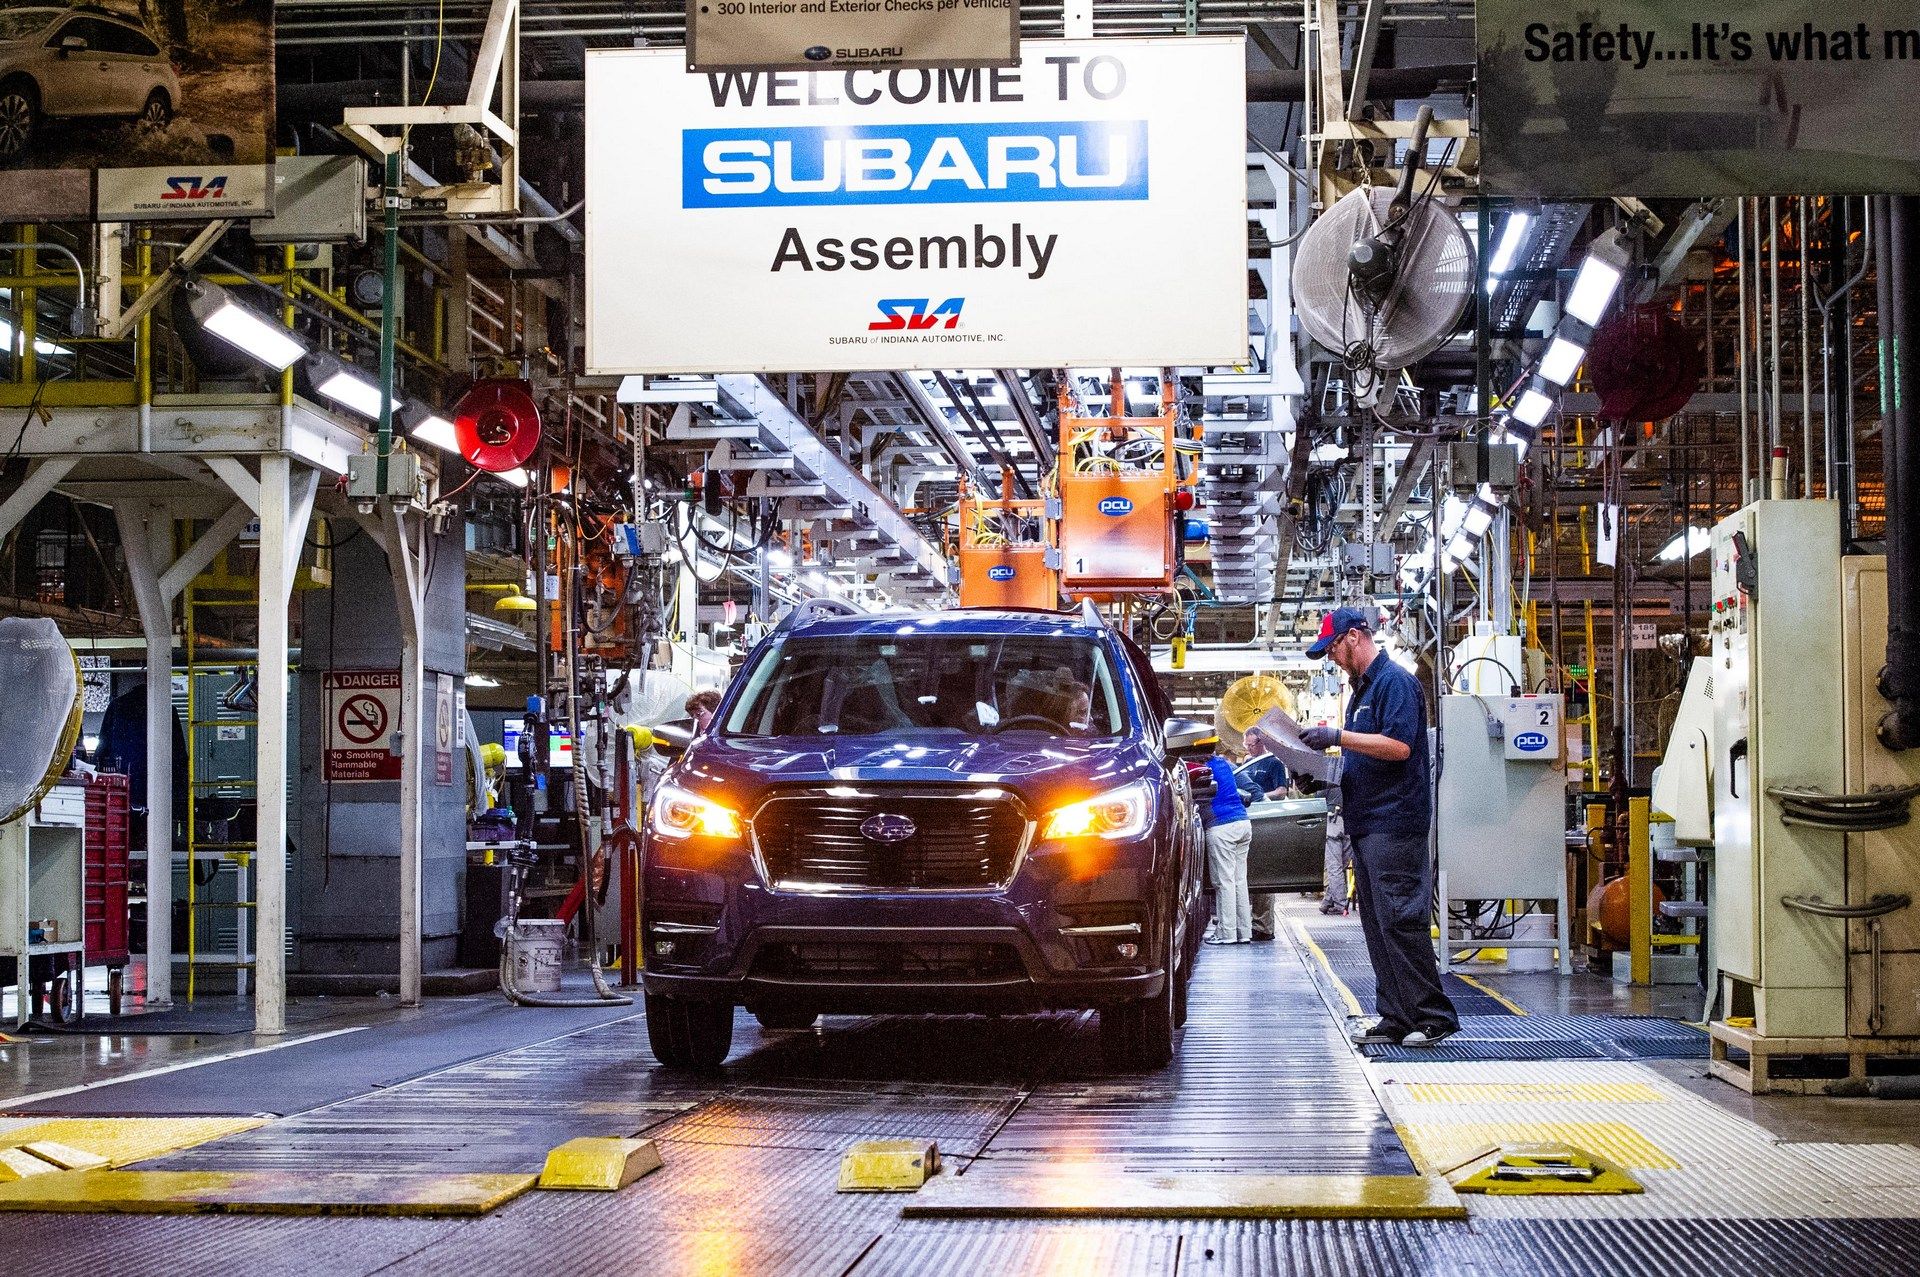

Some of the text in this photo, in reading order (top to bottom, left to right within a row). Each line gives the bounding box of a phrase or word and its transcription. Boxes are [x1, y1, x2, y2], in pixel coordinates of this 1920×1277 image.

[717, 0, 1011, 15] 300 Interior and Exterior Checks per Vehicle
[1765, 22, 1871, 62] what
[835, 48, 903, 59] SUBARU
[706, 55, 1127, 108] WELCOME TO
[702, 134, 1129, 195] SUBARU
[770, 223, 1059, 280] Assembly
[829, 333, 1006, 345] SUBARU of INDIANA AUTOMOTIVE, INC.
[1075, 558, 1084, 574] 1
[342, 673, 400, 687] DANGER
[1539, 711, 1549, 725] 2
[331, 751, 384, 761] No Smoking
[331, 760, 377, 769] Flammable
[331, 770, 370, 778] Materials
